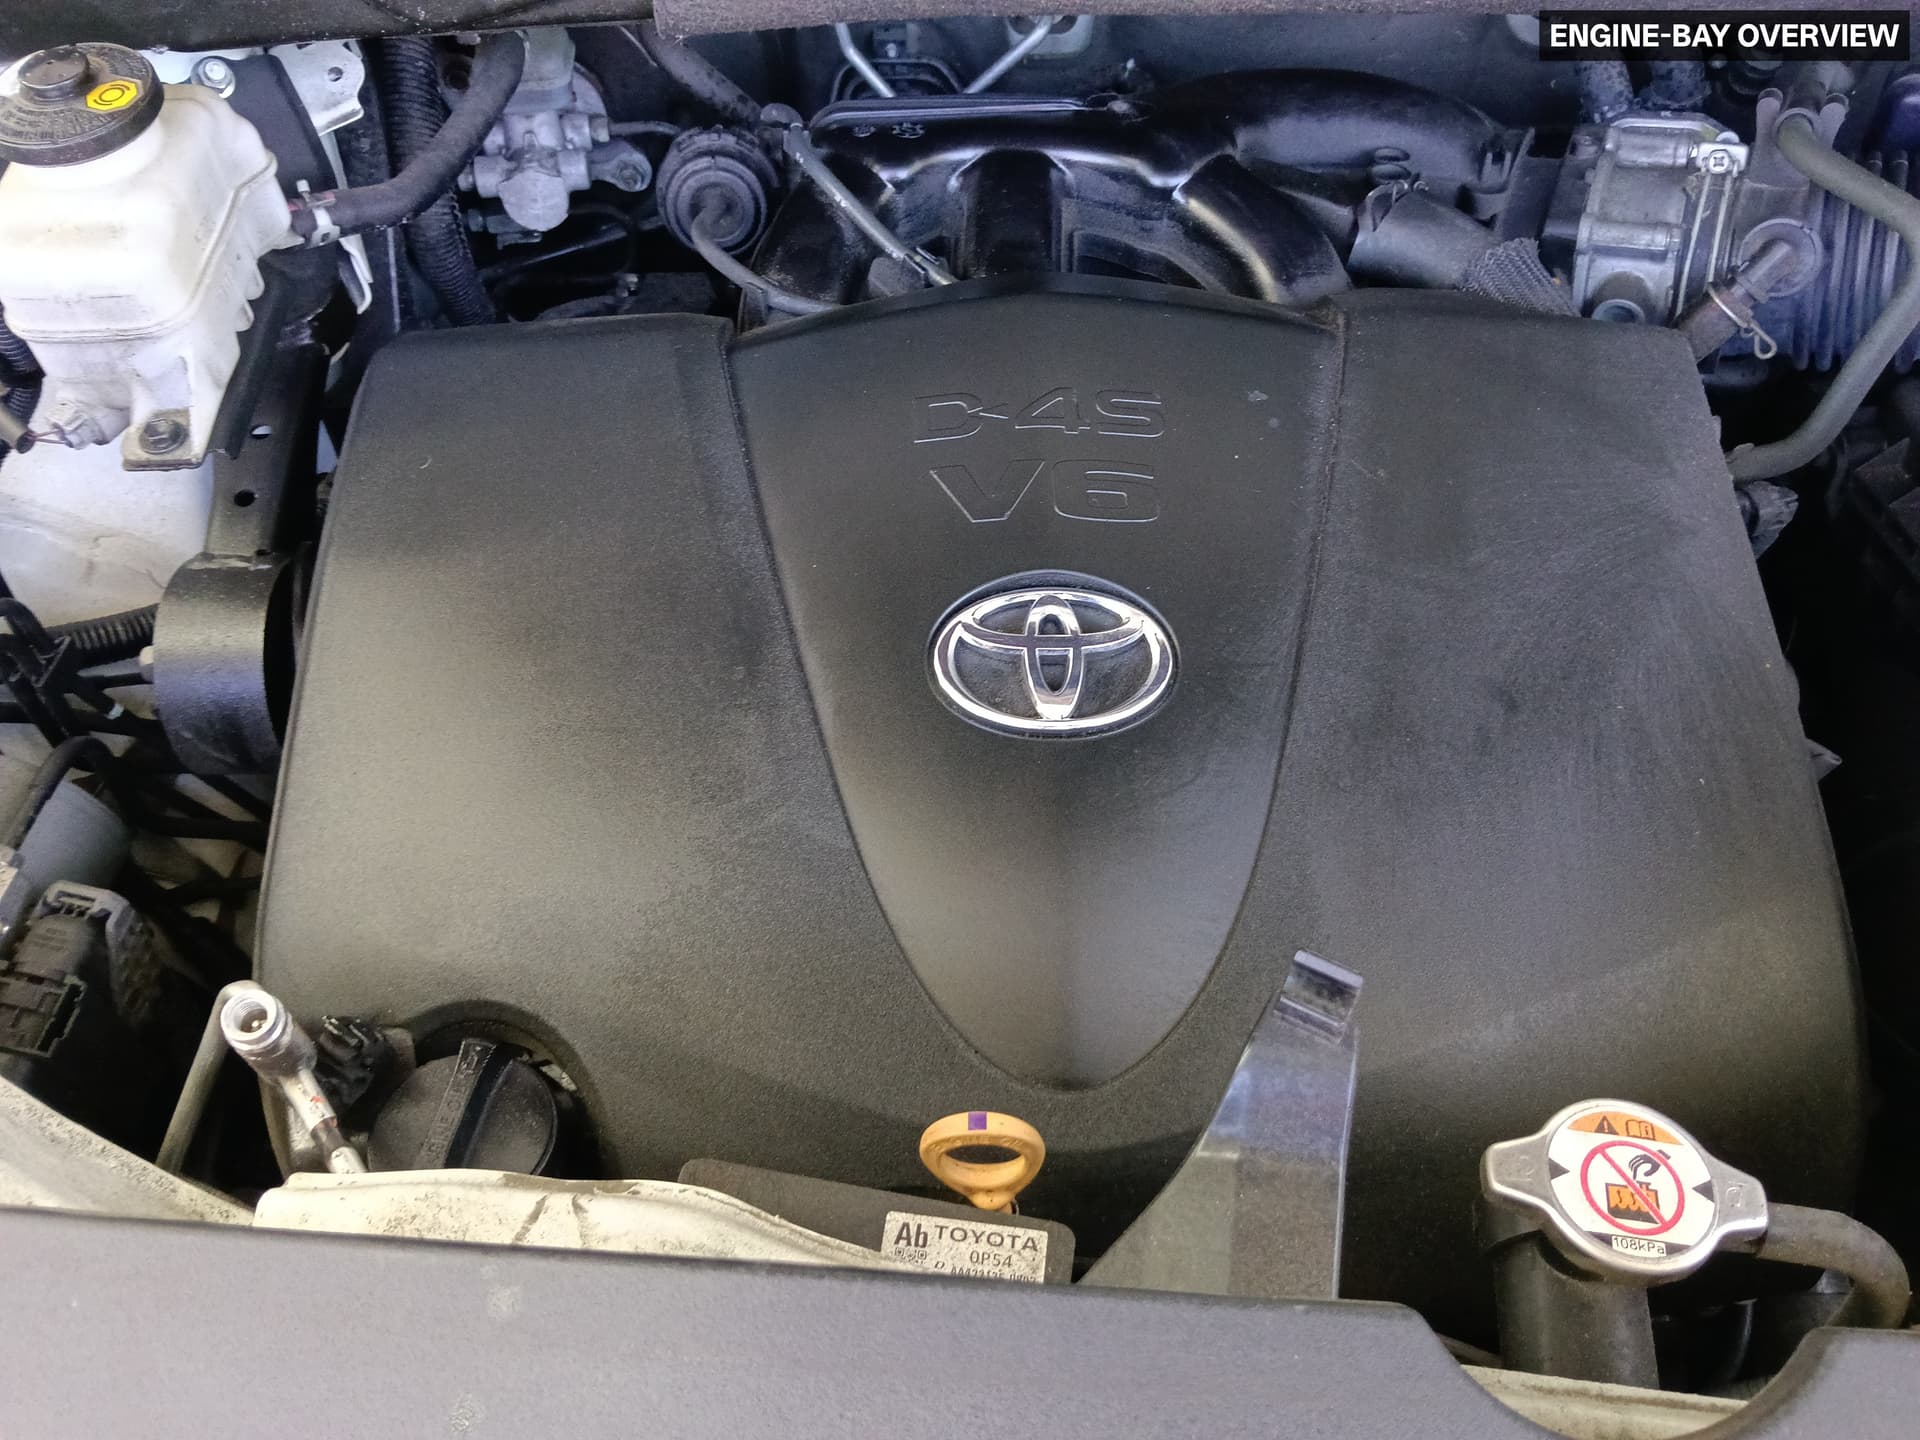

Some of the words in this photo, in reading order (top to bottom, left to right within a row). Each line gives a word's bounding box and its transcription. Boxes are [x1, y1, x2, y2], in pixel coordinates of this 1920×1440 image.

[912, 386, 1166, 444] D-4S
[928, 458, 1161, 523] V6
[894, 1221, 928, 1248] Ab
[934, 1224, 1039, 1252] TOYOTA
[1613, 1236, 1665, 1254] 108kPa
